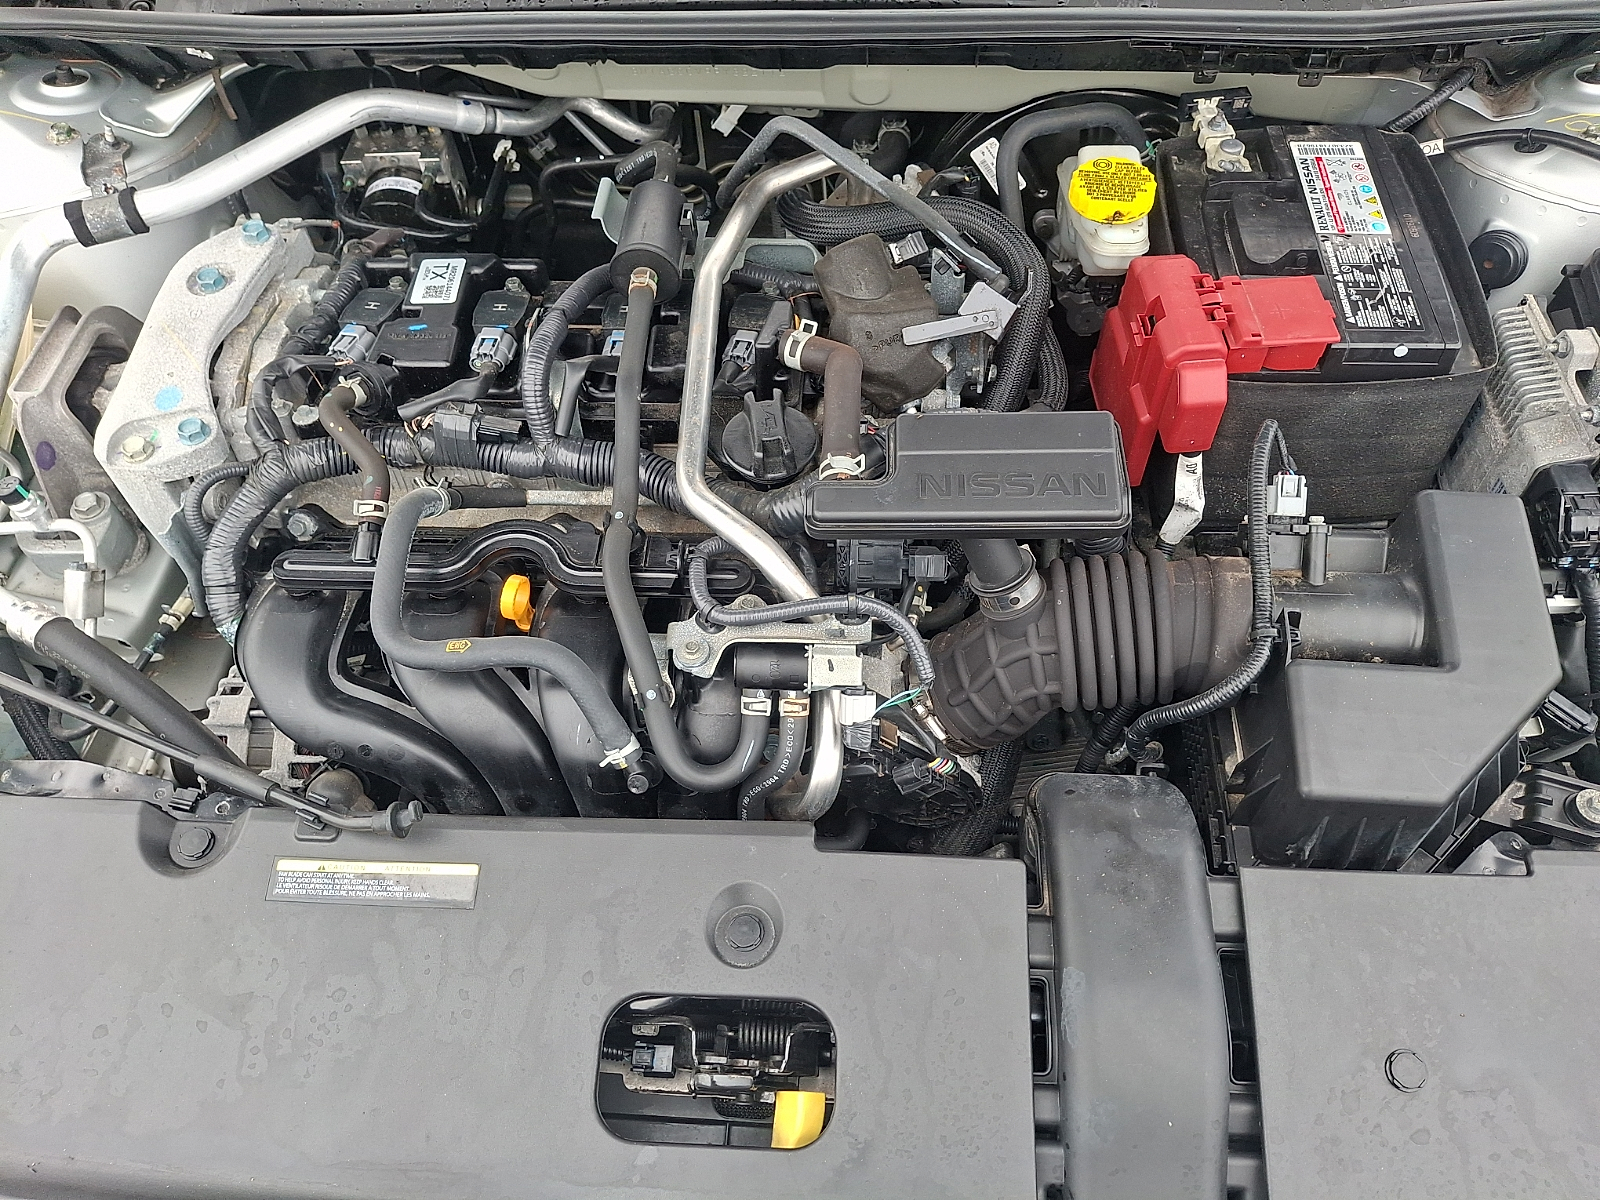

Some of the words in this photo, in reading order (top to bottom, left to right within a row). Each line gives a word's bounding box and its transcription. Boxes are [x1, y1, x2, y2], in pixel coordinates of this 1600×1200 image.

[1299, 158, 1318, 194] NISSAN
[1311, 197, 1329, 231] RENAULT
[430, 262, 450, 280] TX
[917, 472, 1107, 499] NISSAN
